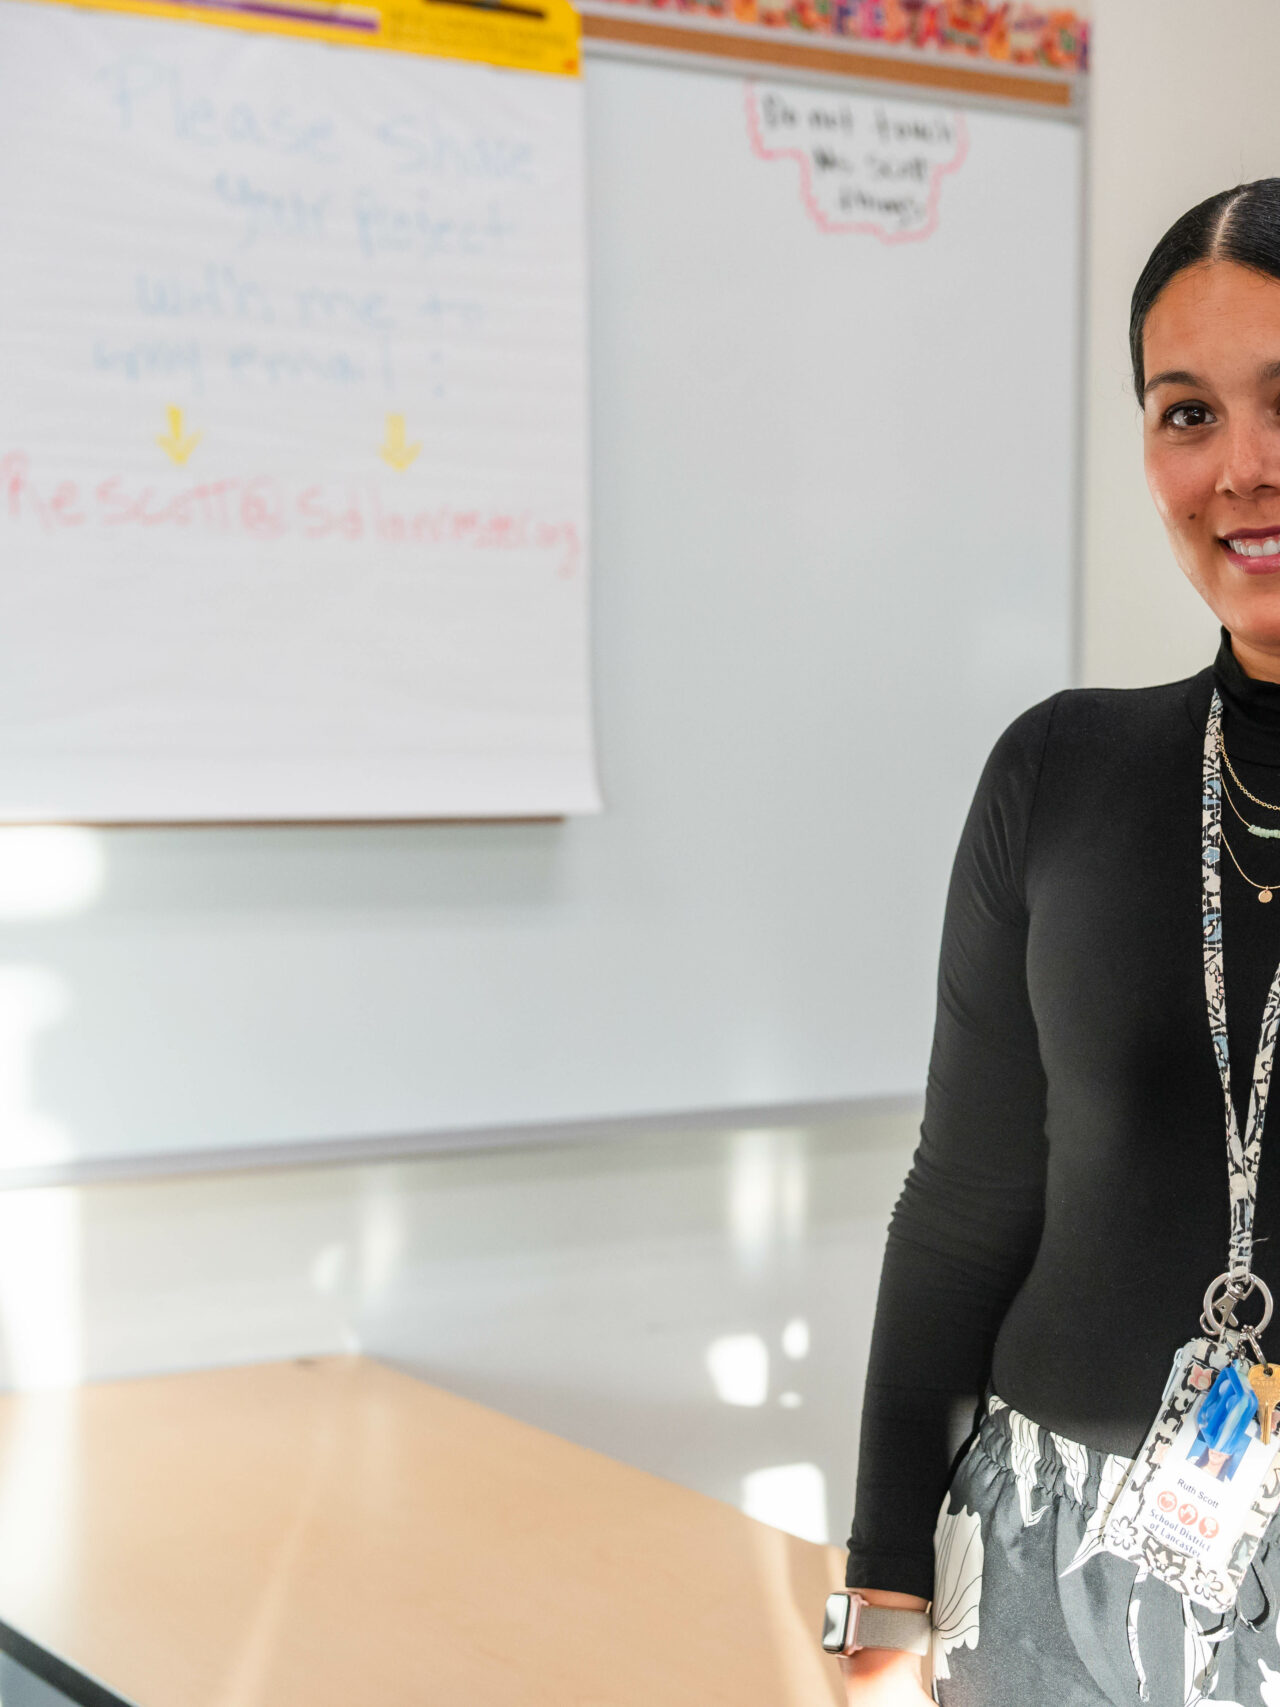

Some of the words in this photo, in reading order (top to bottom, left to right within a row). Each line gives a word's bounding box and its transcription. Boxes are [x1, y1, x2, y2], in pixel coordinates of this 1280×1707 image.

[94, 54, 341, 166] Please
[1177, 1478, 1197, 1495] Ruth
[1197, 1491, 1219, 1509] Scott
[1149, 1508, 1179, 1532] School
[1179, 1527, 1211, 1552] District
[1149, 1522, 1160, 1532] of
[1160, 1527, 1201, 1557] Lancaster
